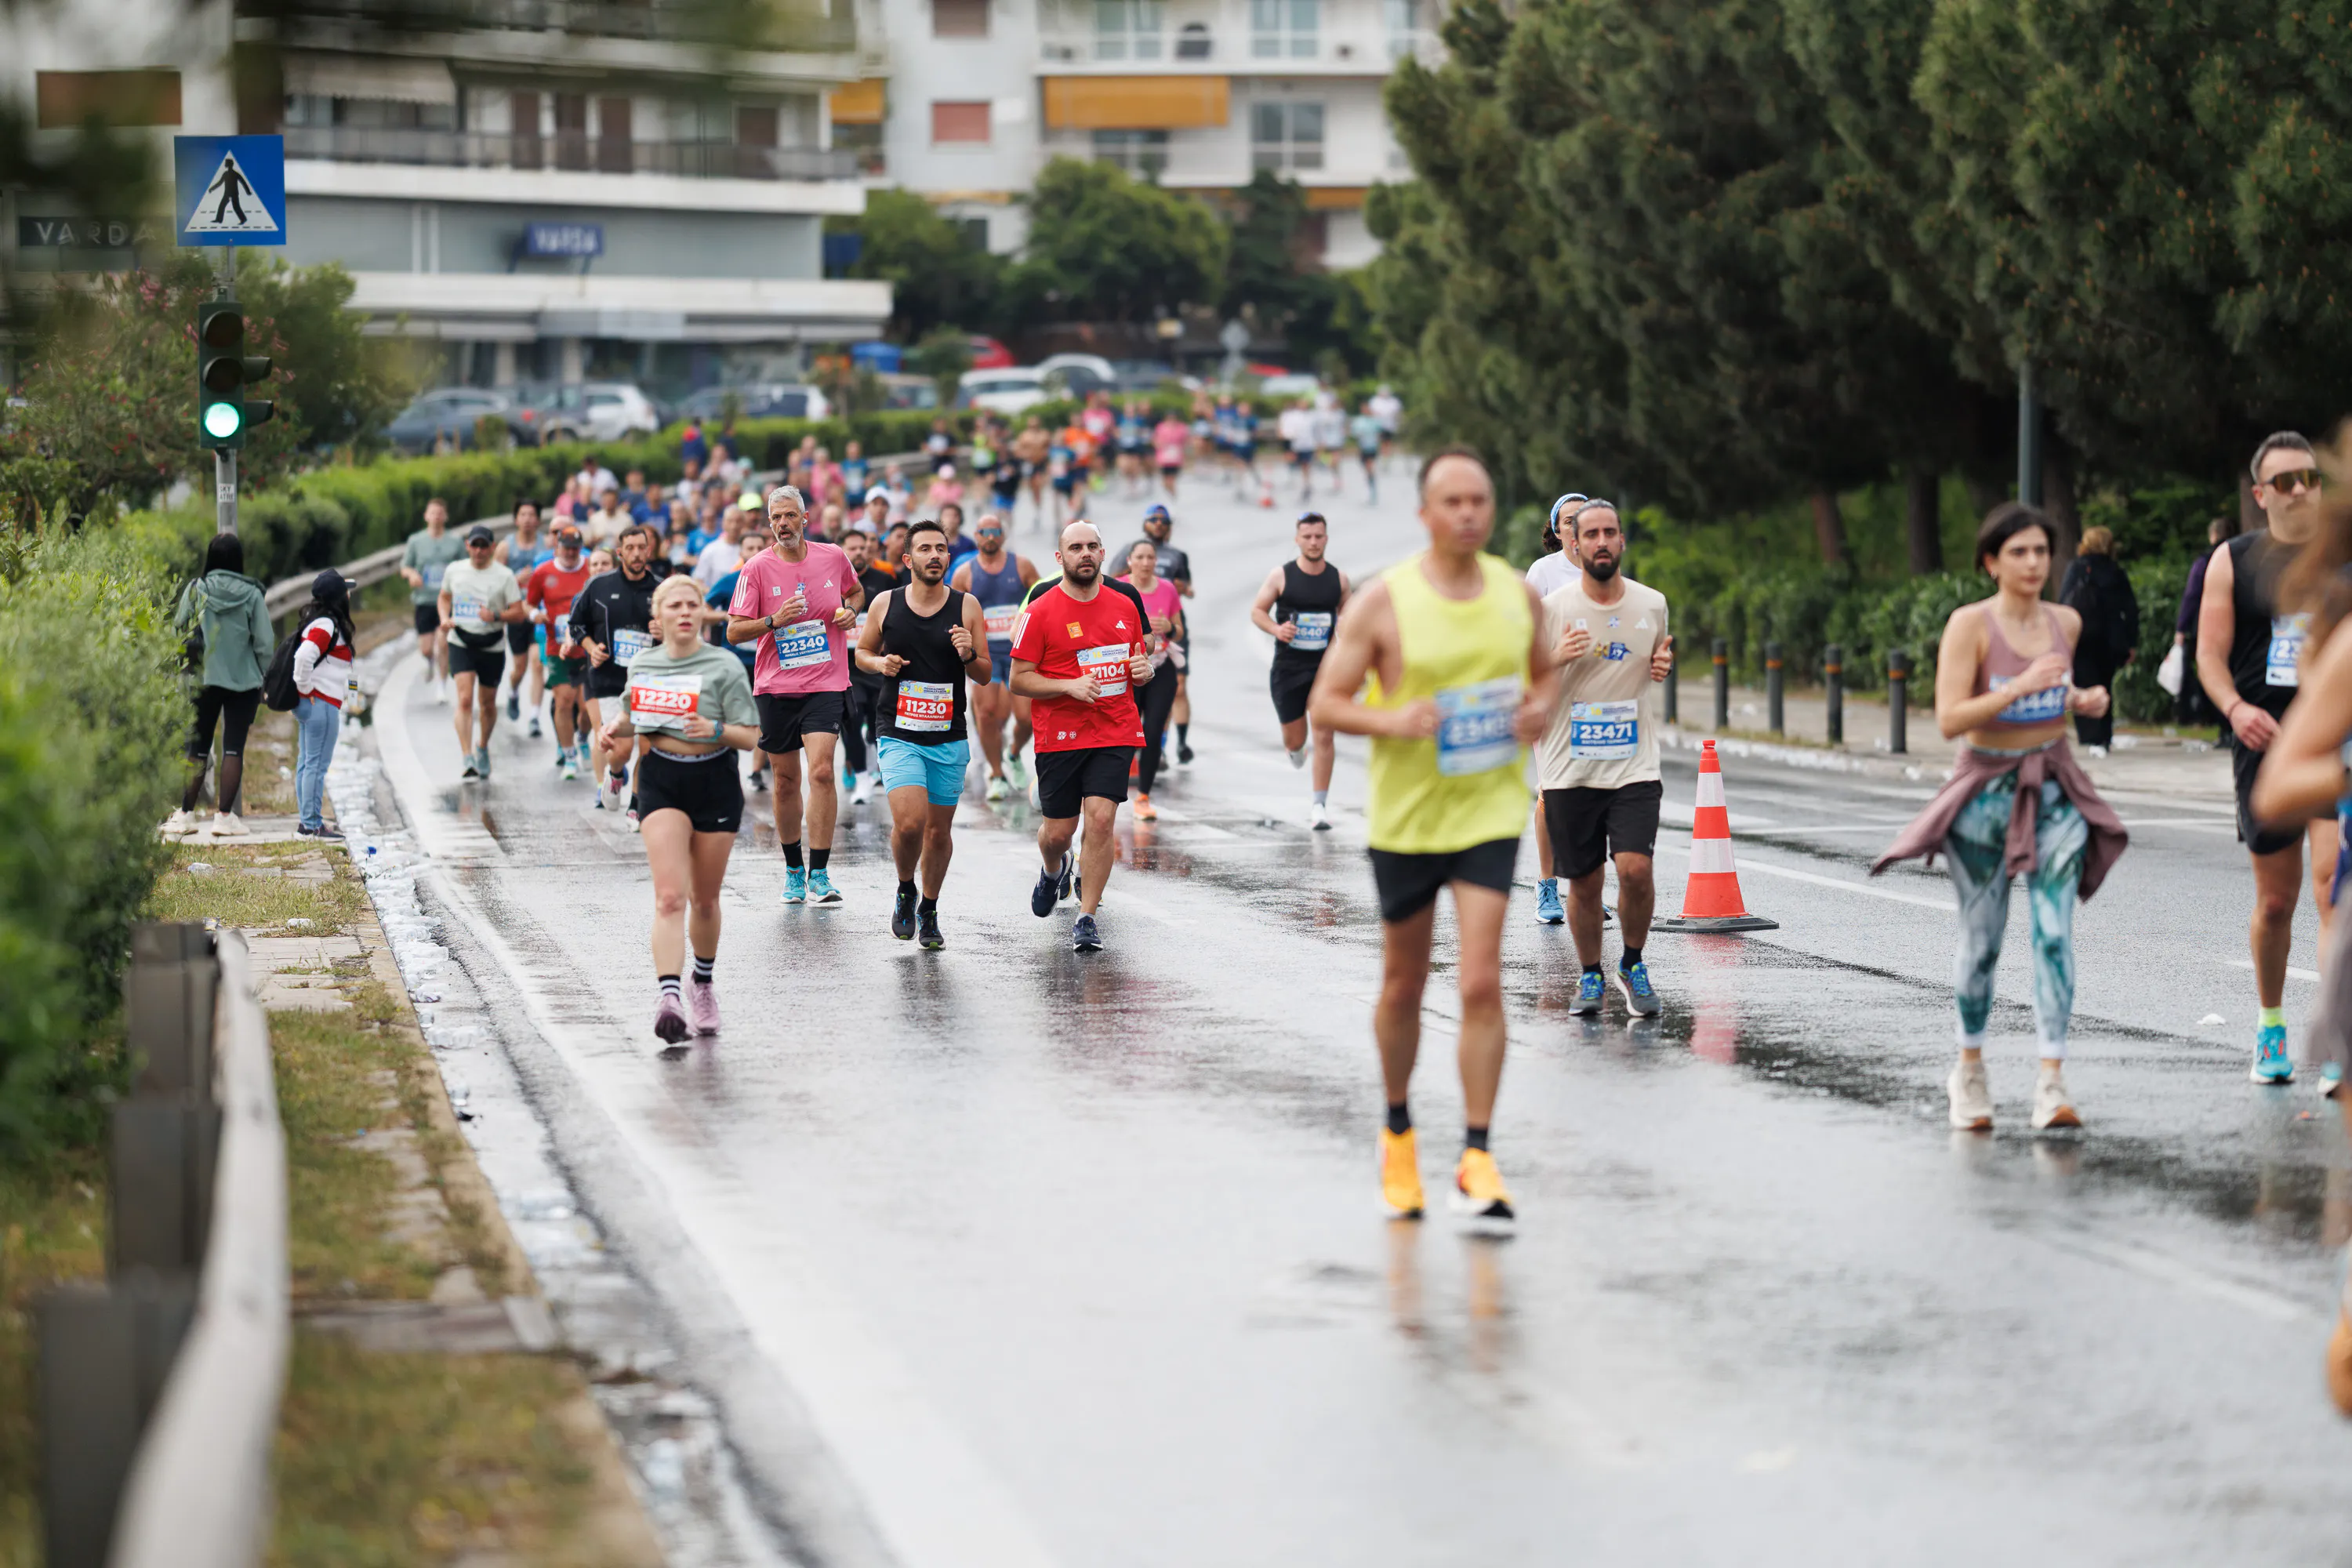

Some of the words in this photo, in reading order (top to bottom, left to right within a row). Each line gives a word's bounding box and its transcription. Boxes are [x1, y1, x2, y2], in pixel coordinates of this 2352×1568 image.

[36, 220, 157, 246] VARDA
[781, 636, 825, 654] 22340
[638, 689, 691, 710] 12220
[906, 699, 947, 714] 11230
[1580, 722, 1632, 739] 23471
